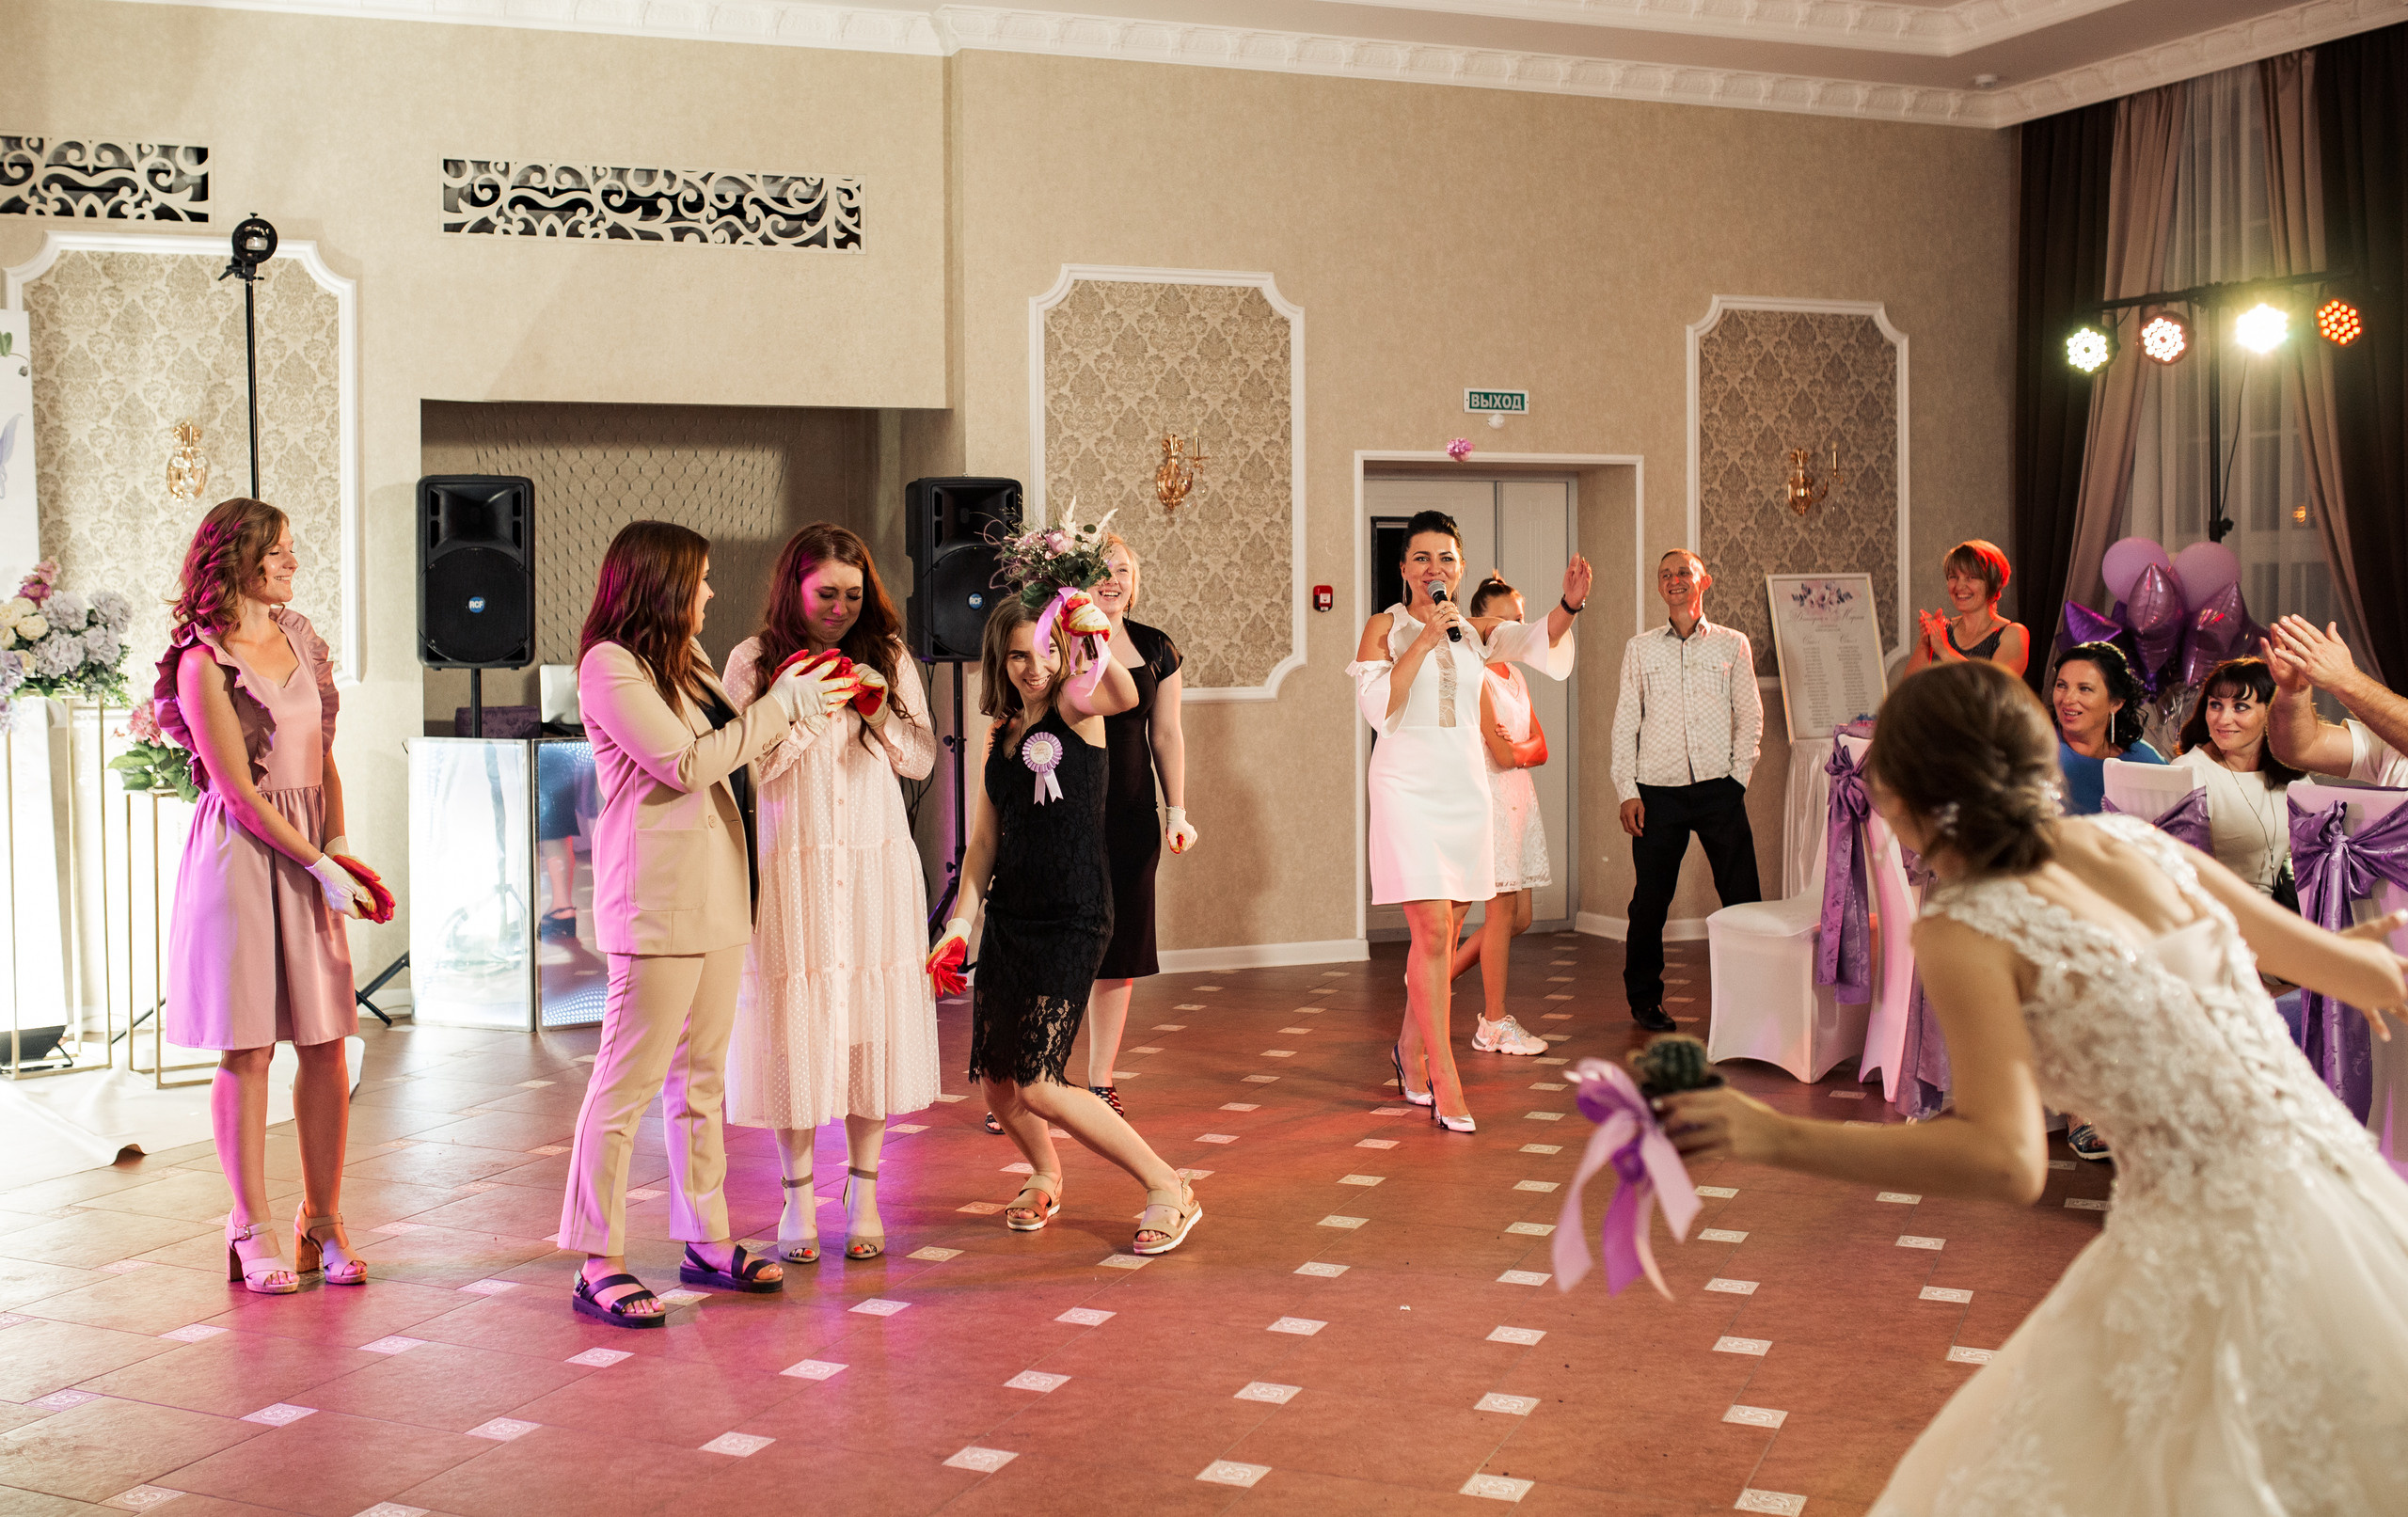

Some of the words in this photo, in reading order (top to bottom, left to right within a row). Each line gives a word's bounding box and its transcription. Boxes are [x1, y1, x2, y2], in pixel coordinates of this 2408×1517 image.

[1471, 393, 1522, 410] ВЫХОД
[468, 600, 483, 608] RCF
[969, 596, 982, 605] RCF
